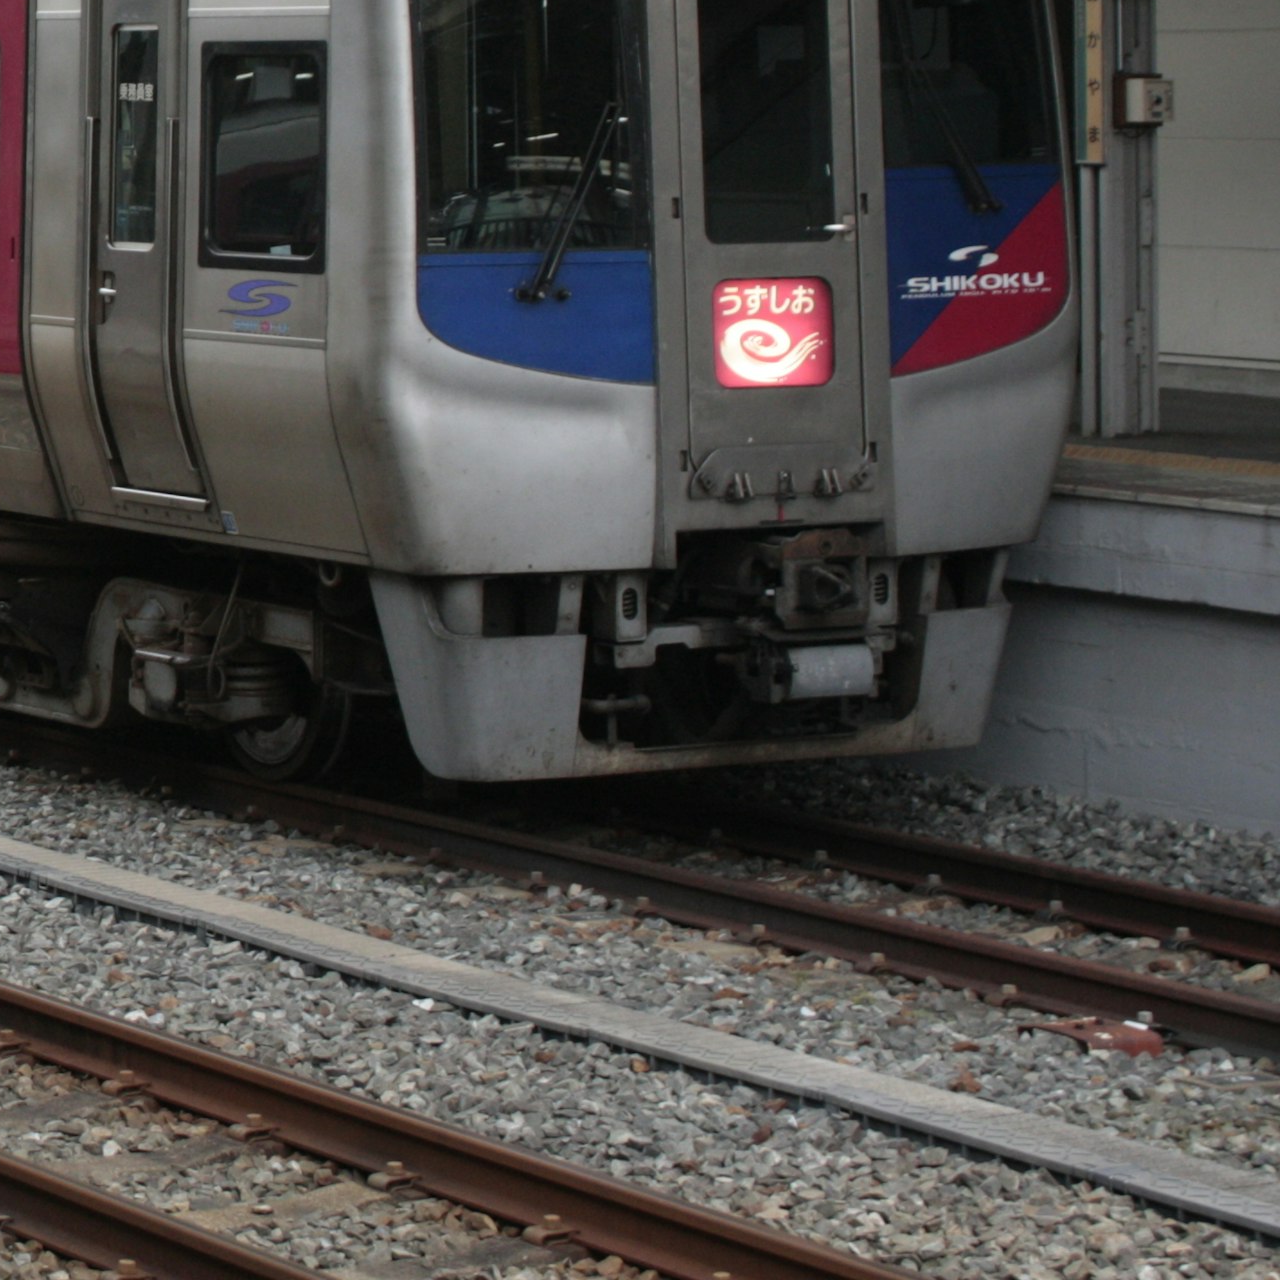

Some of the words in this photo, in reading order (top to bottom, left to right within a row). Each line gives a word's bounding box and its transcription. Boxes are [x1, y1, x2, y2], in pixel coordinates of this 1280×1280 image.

[906, 271, 1045, 294] SHIKOKU
[719, 285, 815, 316] うずしお
